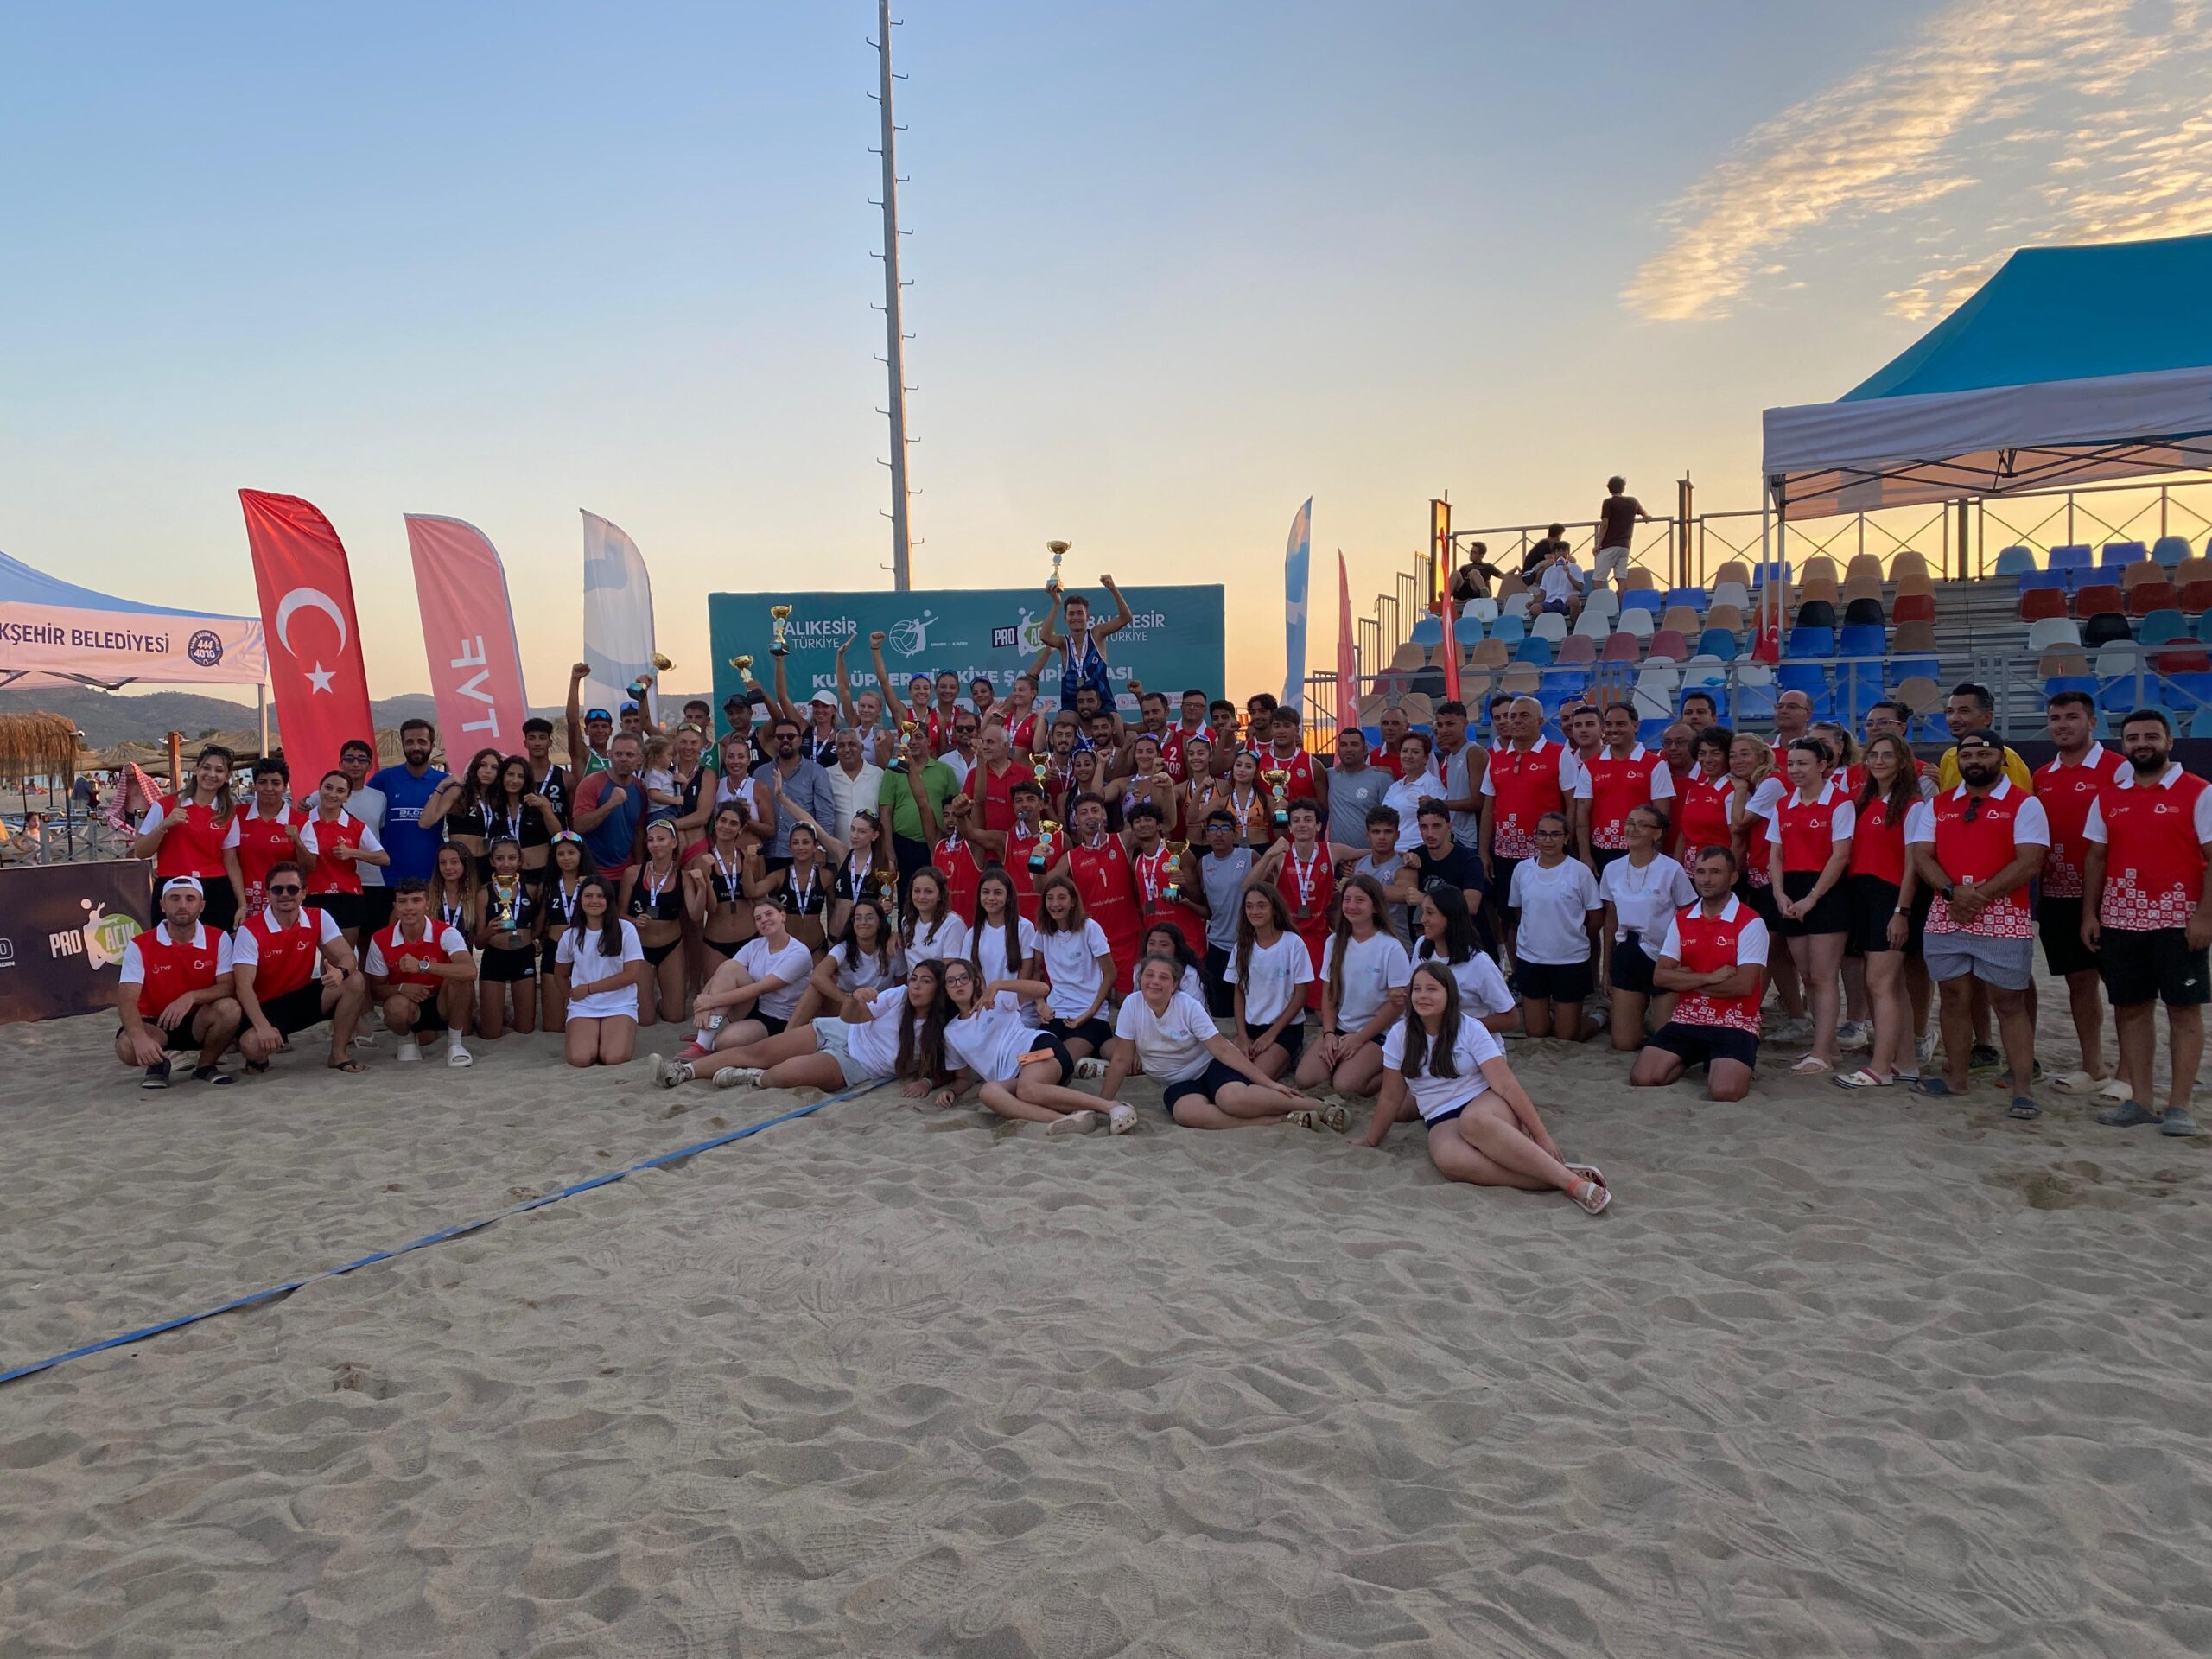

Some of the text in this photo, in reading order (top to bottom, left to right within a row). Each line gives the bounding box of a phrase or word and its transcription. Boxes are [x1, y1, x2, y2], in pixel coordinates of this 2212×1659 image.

[71, 629, 169, 653] BELEDİYESİ
[791, 635, 840, 649] TÜRKİYE
[994, 628, 1015, 646] PRO
[198, 639, 213, 649] 444
[194, 649, 215, 658] 4010
[812, 670, 912, 688] KUÜPER
[932, 725, 938, 734] 4
[1170, 747, 1177, 760] 2
[705, 755, 713, 766] 2
[550, 785, 560, 798] 2
[692, 785, 696, 796] 1
[469, 806, 477, 817] 2
[1255, 807, 1261, 817] 1
[836, 878, 842, 893] 4
[552, 898, 560, 909] 2
[634, 900, 643, 912] 3
[780, 893, 787, 907] 2
[493, 902, 499, 913] 1
[49, 930, 82, 958] PRO
